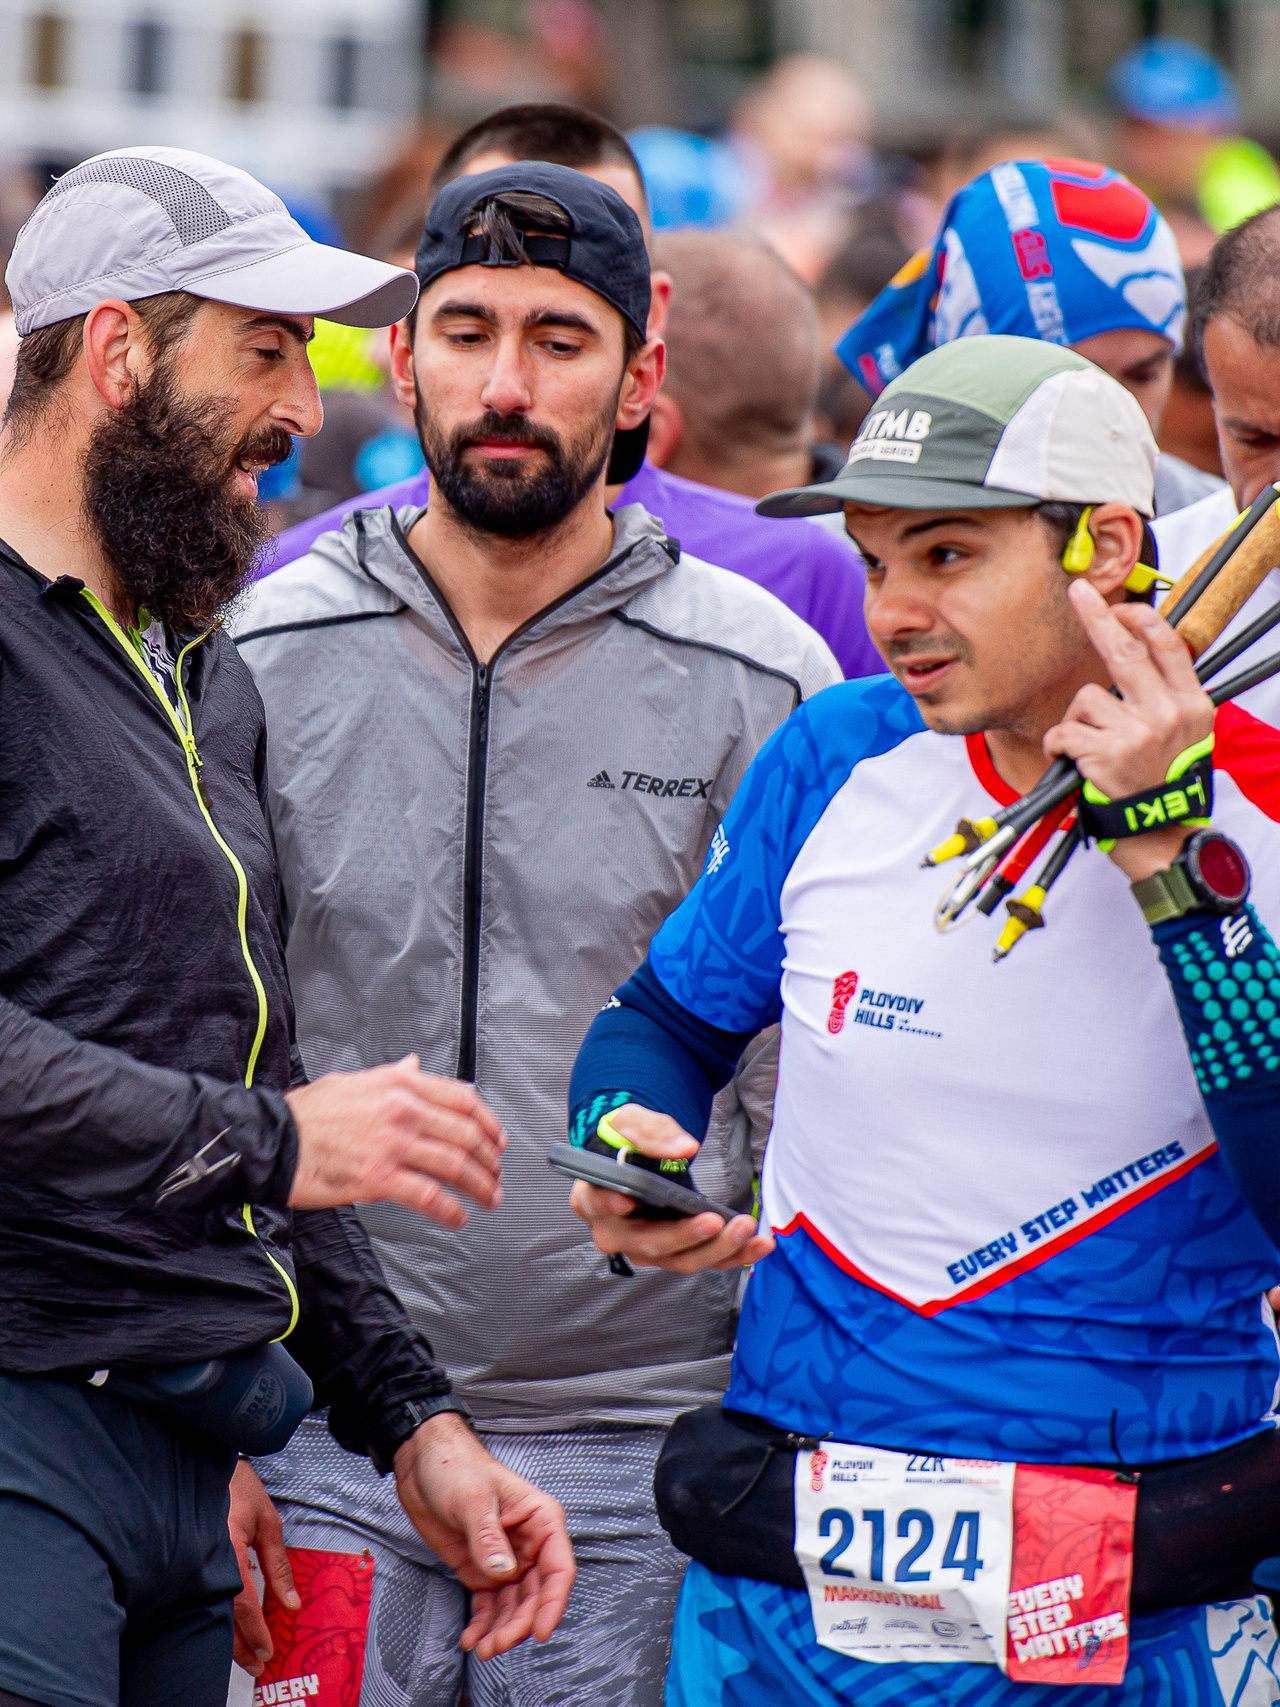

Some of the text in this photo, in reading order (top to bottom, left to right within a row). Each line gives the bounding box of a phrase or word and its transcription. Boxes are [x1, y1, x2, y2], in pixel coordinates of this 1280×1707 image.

[586, 781, 615, 789] adidas
[621, 770, 713, 799] TERREX
[1124, 775, 1207, 831] LEKI
[854, 1008, 895, 1030] HILLS
[860, 989, 925, 1014] PLOVDIV
[946, 1140, 1187, 1285] EVERY STEP MATTERS
[819, 1507, 984, 1582] 2124
[824, 1584, 947, 1611] MARKOVO TRAIL
[1007, 1573, 1085, 1617] EVERY
[1007, 1602, 1074, 1642] STEP
[1013, 1611, 1129, 1664] MATTERS
[254, 1673, 320, 1707] EVERY
